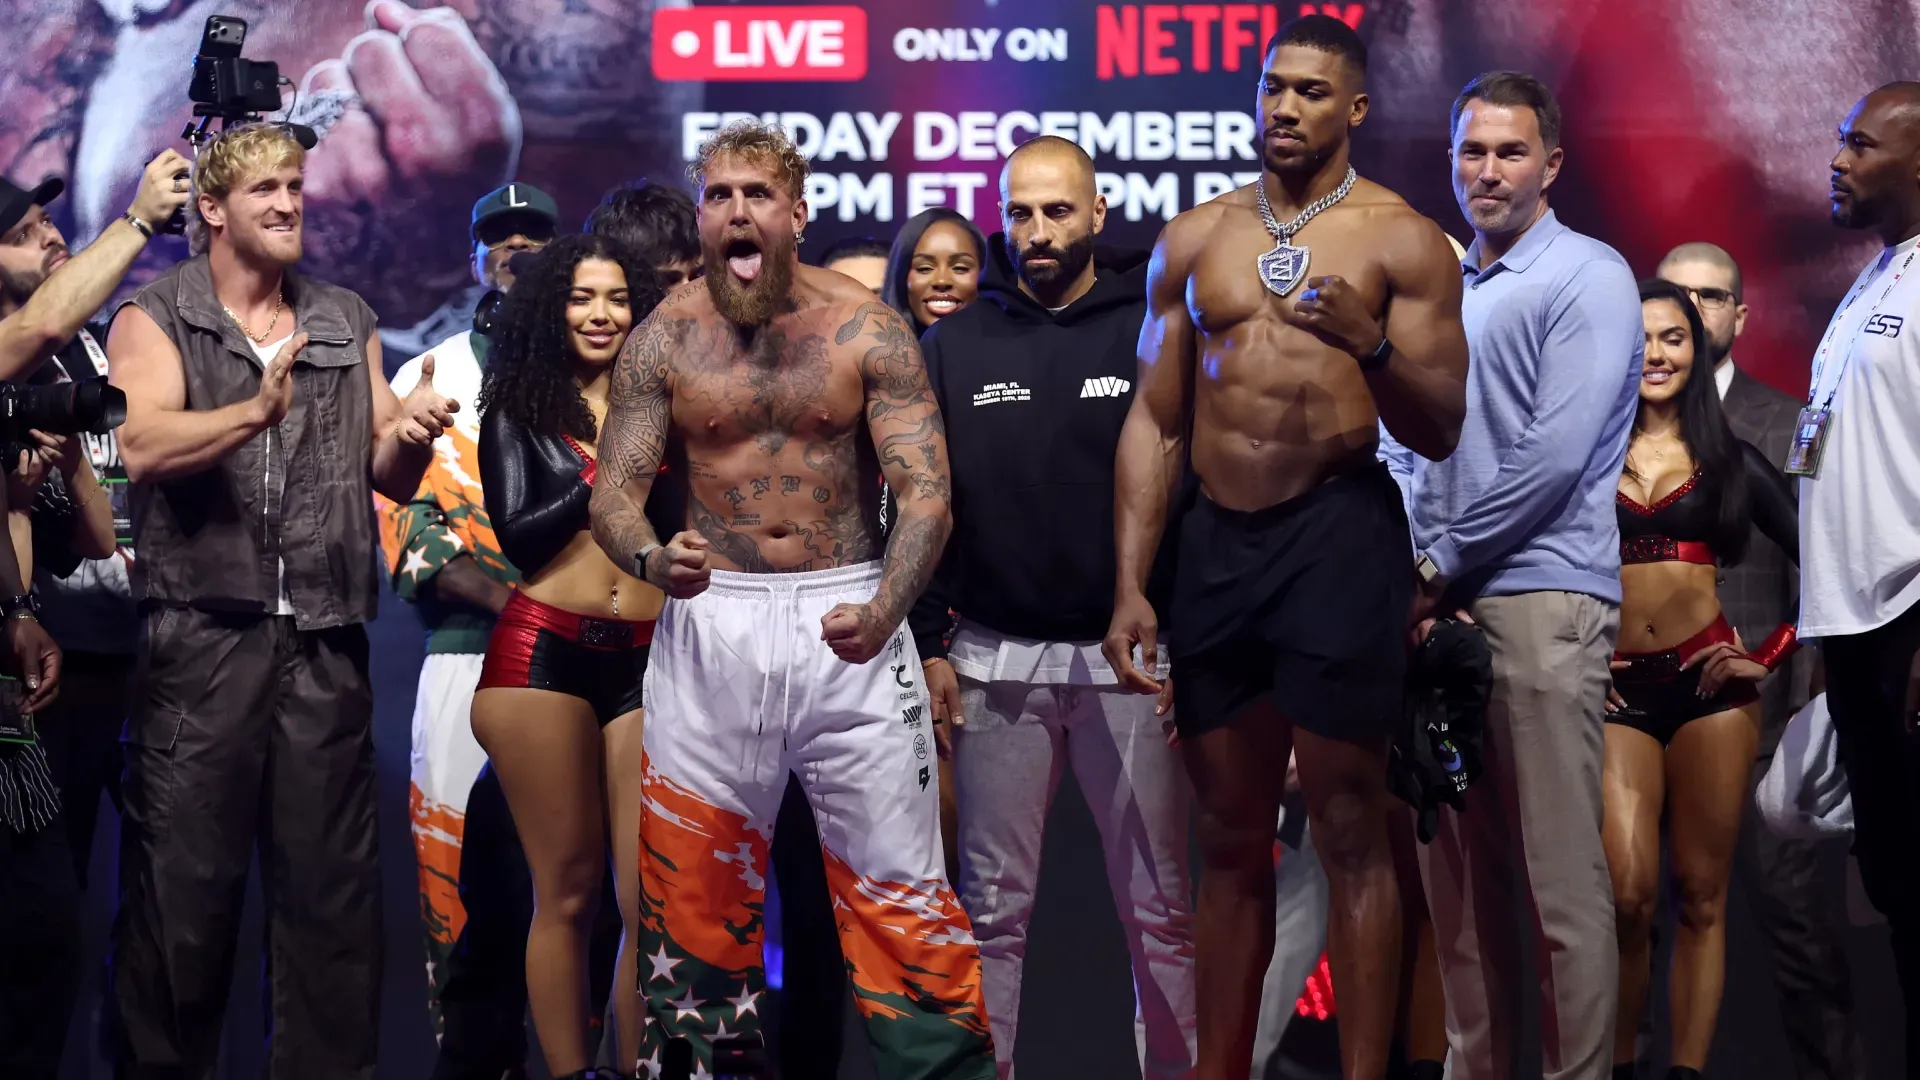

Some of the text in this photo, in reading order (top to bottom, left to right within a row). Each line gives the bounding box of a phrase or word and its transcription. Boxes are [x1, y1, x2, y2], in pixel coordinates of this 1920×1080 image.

[713, 20, 845, 67] LIVE
[893, 27, 1001, 62] ONLY
[1004, 27, 1068, 62] ON
[682, 111, 902, 161] FDAY
[509, 184, 528, 208] L
[907, 172, 988, 221] ET
[1001, 388, 1031, 396] CENTER
[1009, 381, 1020, 389] FL
[1080, 376, 1130, 398] MVP
